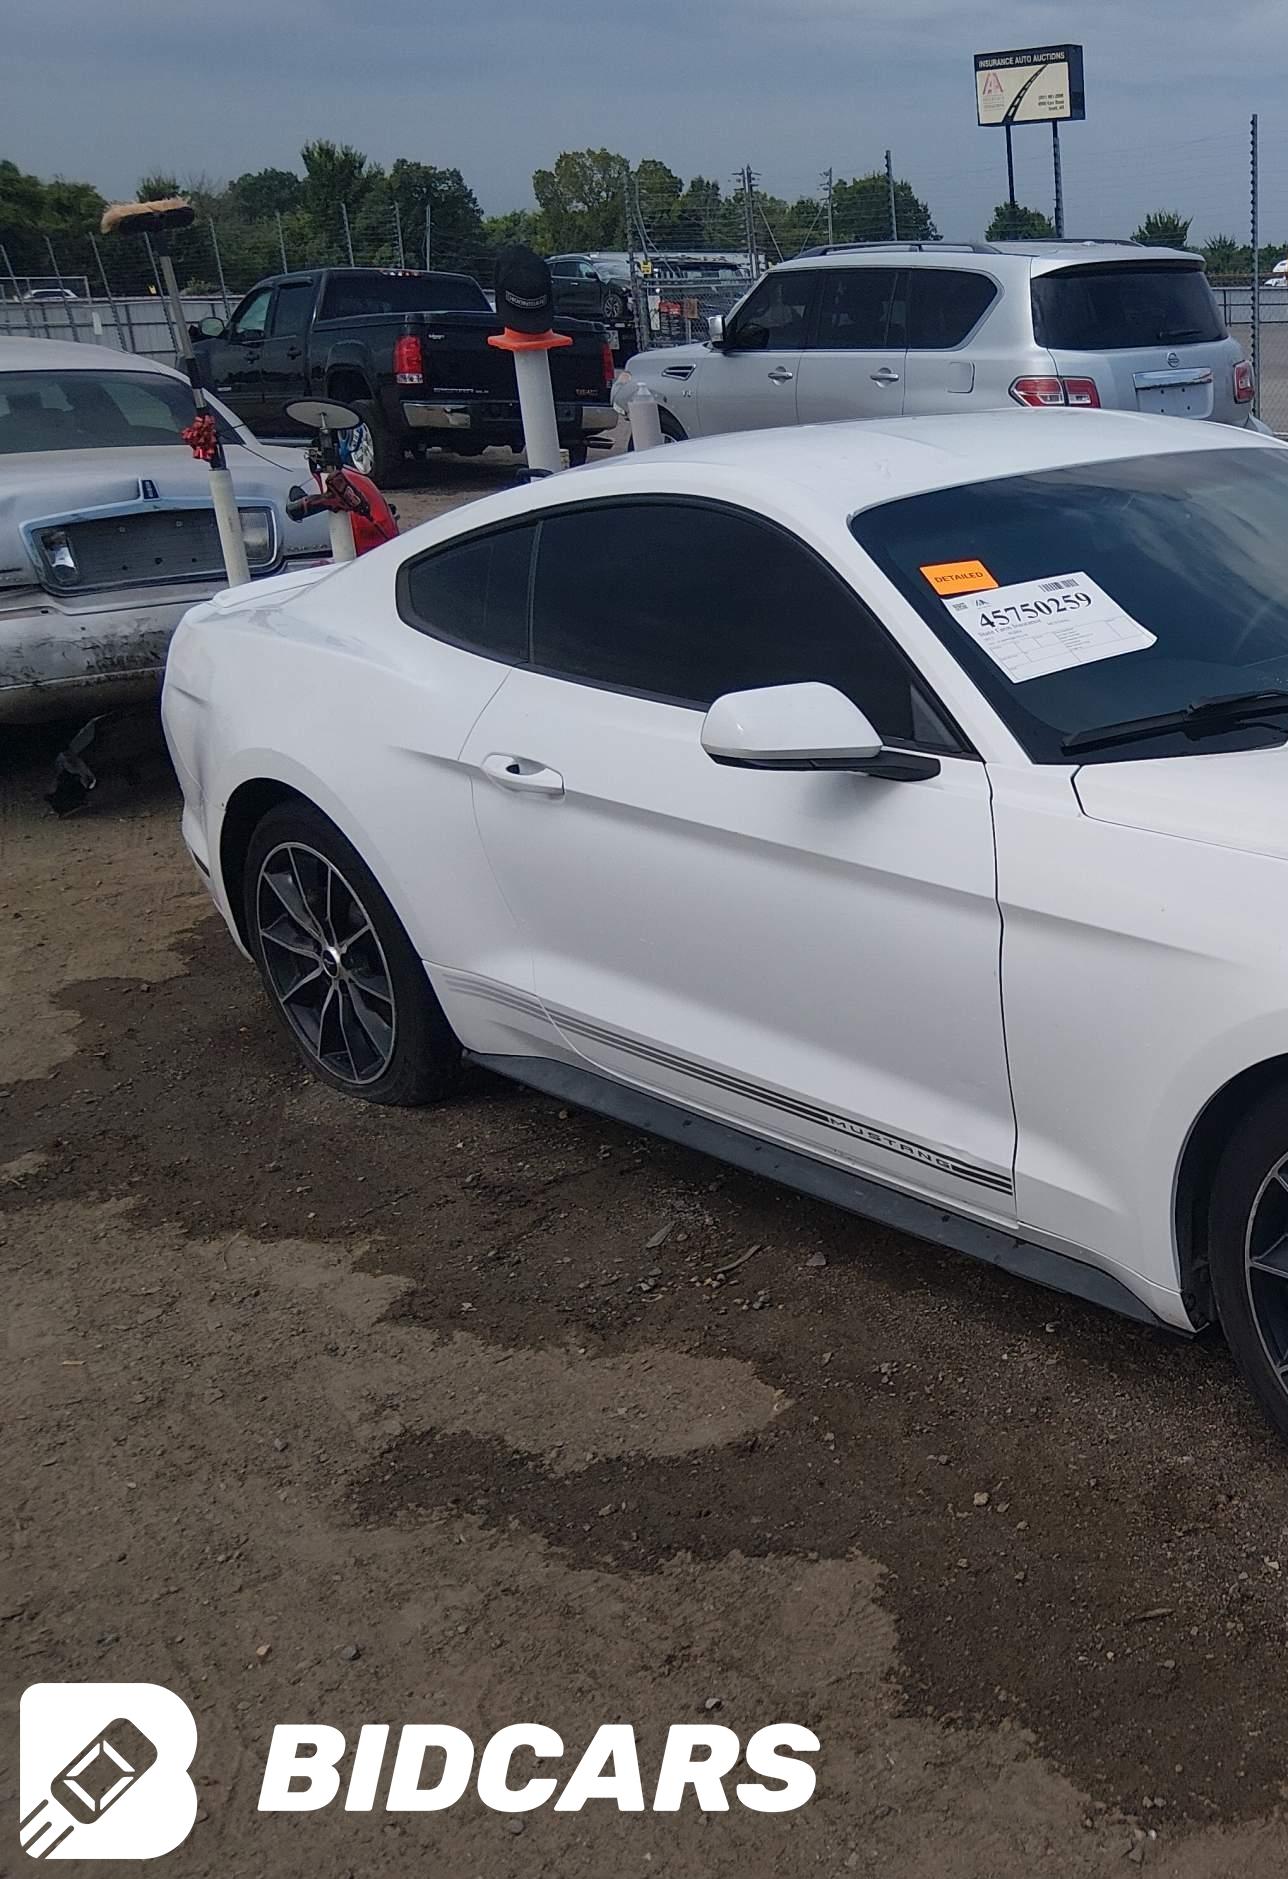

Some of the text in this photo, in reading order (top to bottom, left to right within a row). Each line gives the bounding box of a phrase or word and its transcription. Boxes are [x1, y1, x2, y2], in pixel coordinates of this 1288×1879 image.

[979, 51, 1065, 68] INSURANCE AUTO AUCTIONS
[934, 571, 984, 584] DETAILED
[980, 592, 1092, 628] 45750259
[830, 1118, 951, 1168] MUSTANG
